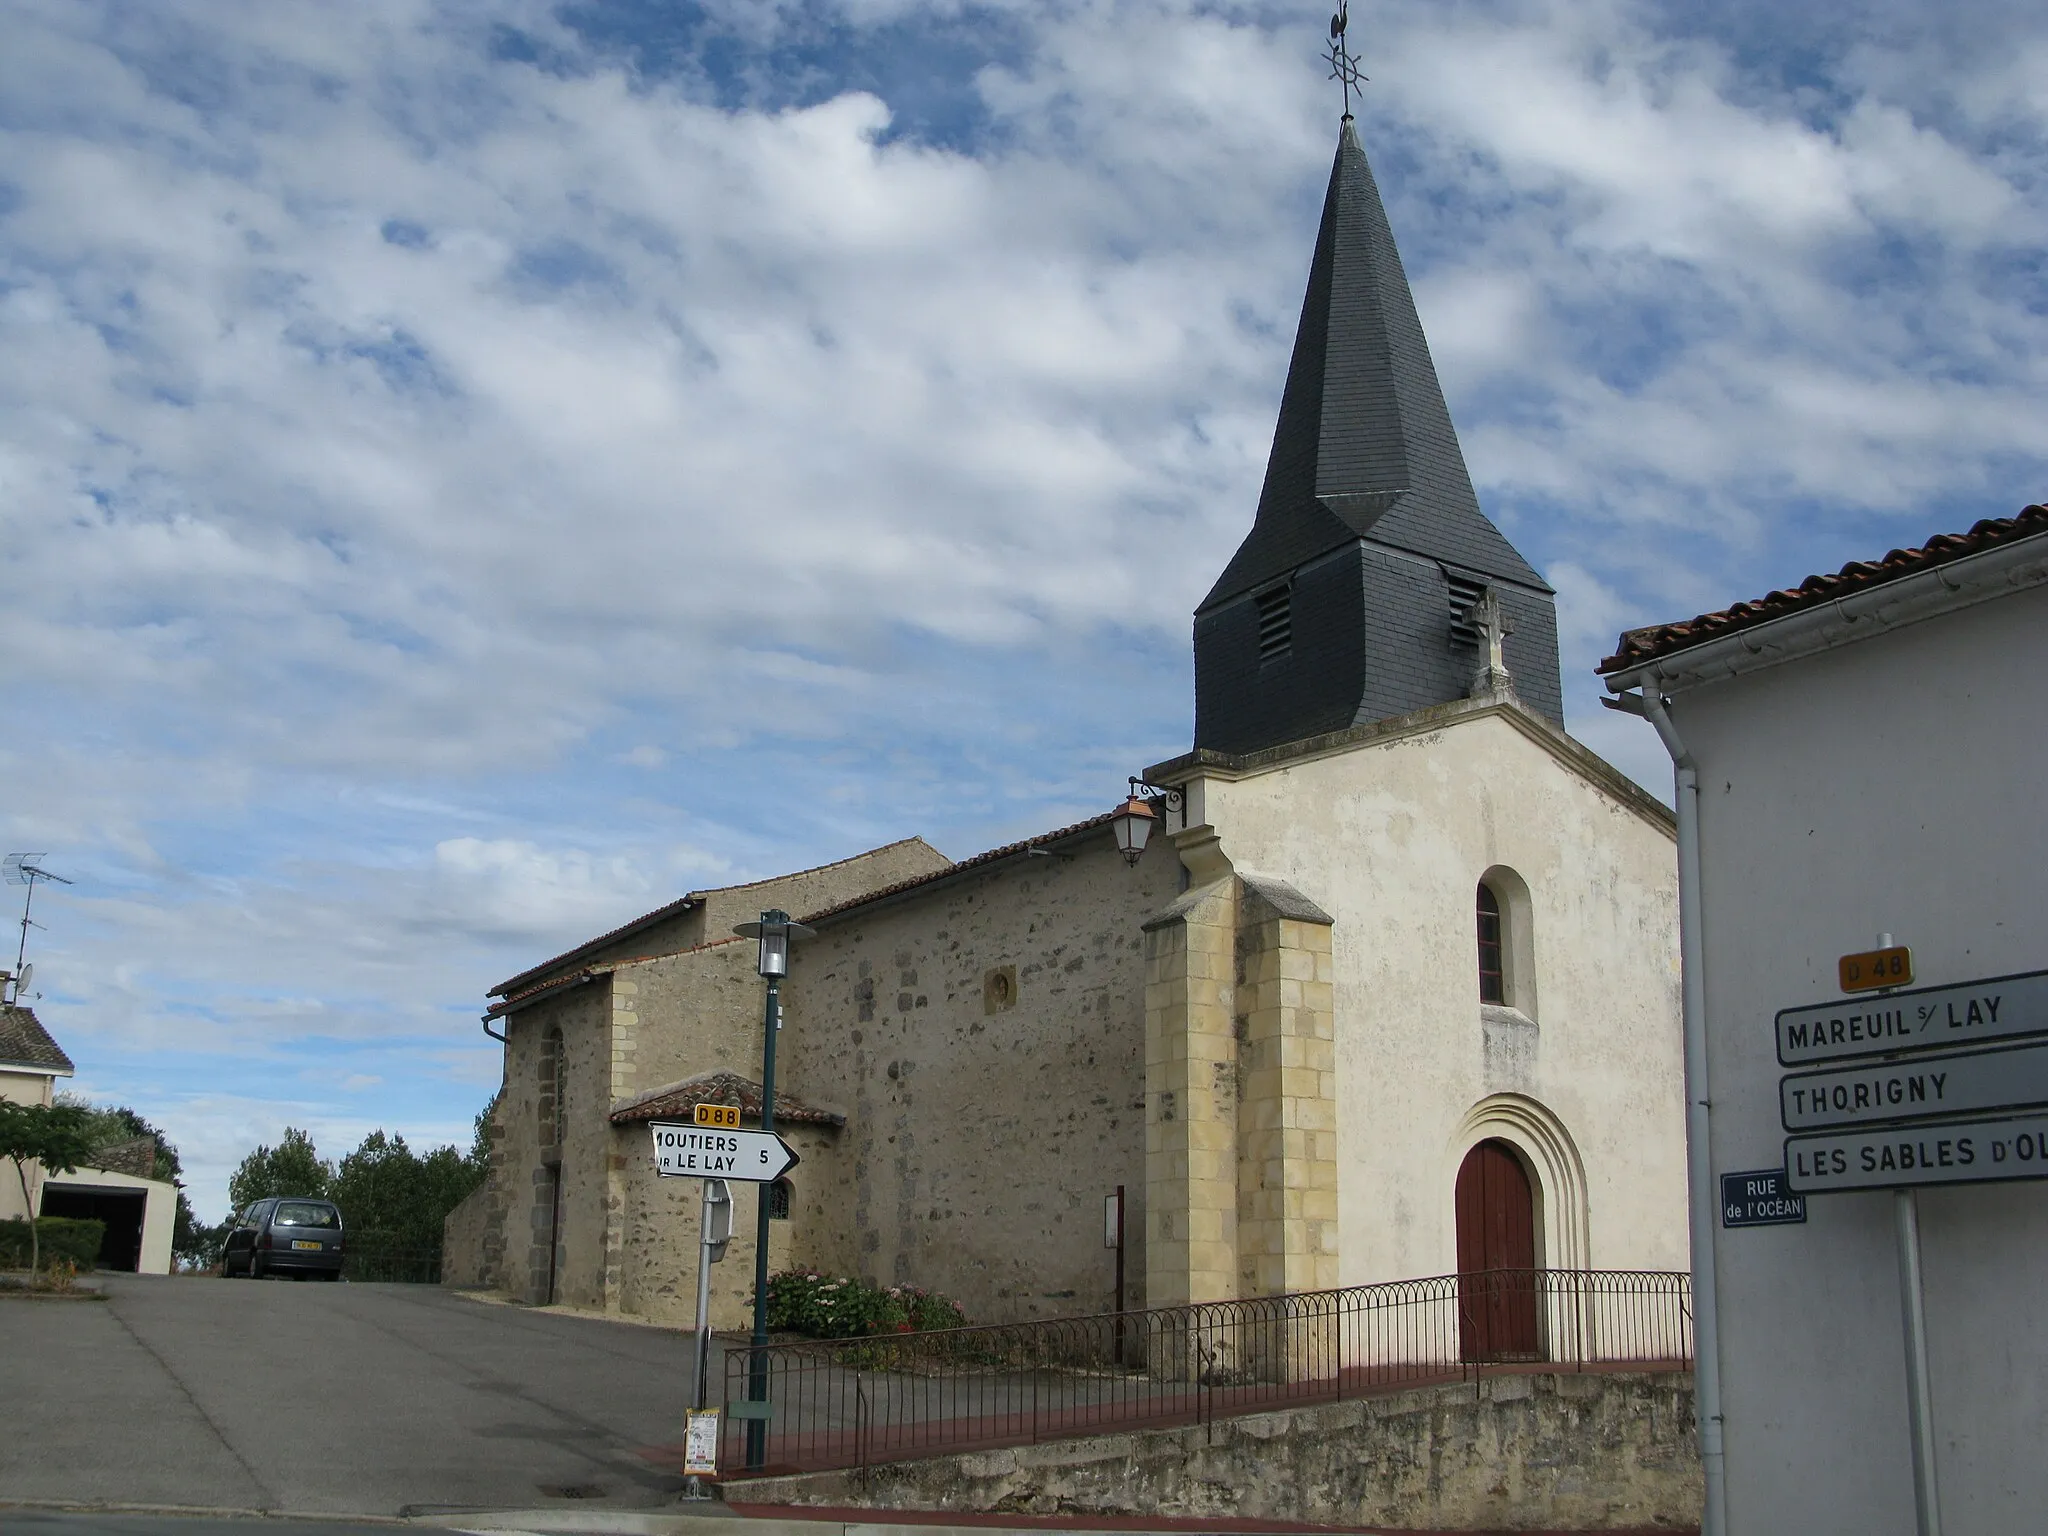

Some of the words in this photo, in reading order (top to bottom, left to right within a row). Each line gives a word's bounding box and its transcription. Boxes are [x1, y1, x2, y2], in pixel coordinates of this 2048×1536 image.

[1849, 961, 1859, 981] D
[1873, 955, 1902, 977] 48
[1788, 1010, 1910, 1049] MAREUIL
[1948, 997, 2001, 1028] LAY
[1792, 1073, 1947, 1115] THORIGNY
[700, 1107, 709, 1122] D
[714, 1109, 736, 1124] 88
[678, 1153, 697, 1168] LE
[704, 1155, 736, 1171] LAY
[759, 1150, 769, 1164] 5
[1797, 1149, 1847, 1177] LES
[1861, 1138, 1975, 1172] SABLES
[1747, 1179, 1776, 1196] RUE
[1727, 1203, 1742, 1218] de
[1748, 1197, 1801, 1217] l'OCÉAN
